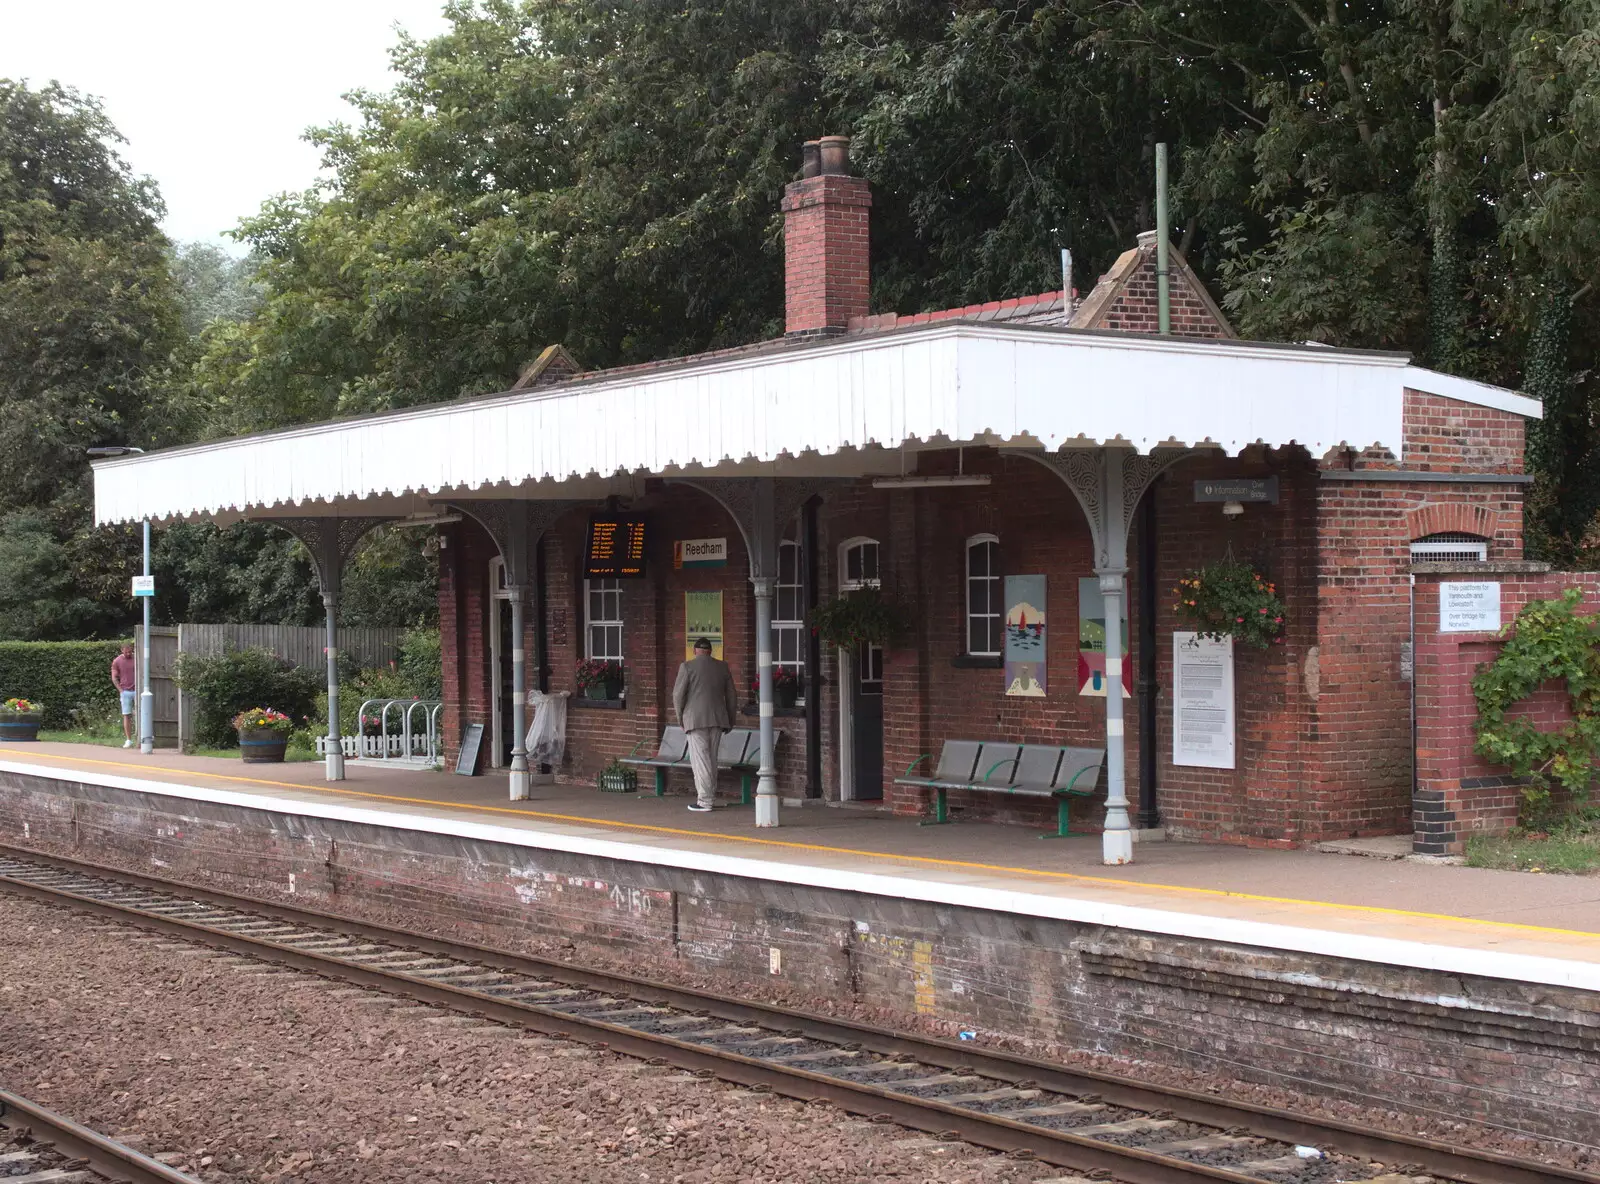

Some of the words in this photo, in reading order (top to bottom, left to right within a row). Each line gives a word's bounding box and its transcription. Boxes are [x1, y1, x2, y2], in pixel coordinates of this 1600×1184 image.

[1214, 484, 1248, 495] Information
[685, 543, 723, 556] Reedham
[1460, 584, 1481, 592] platform
